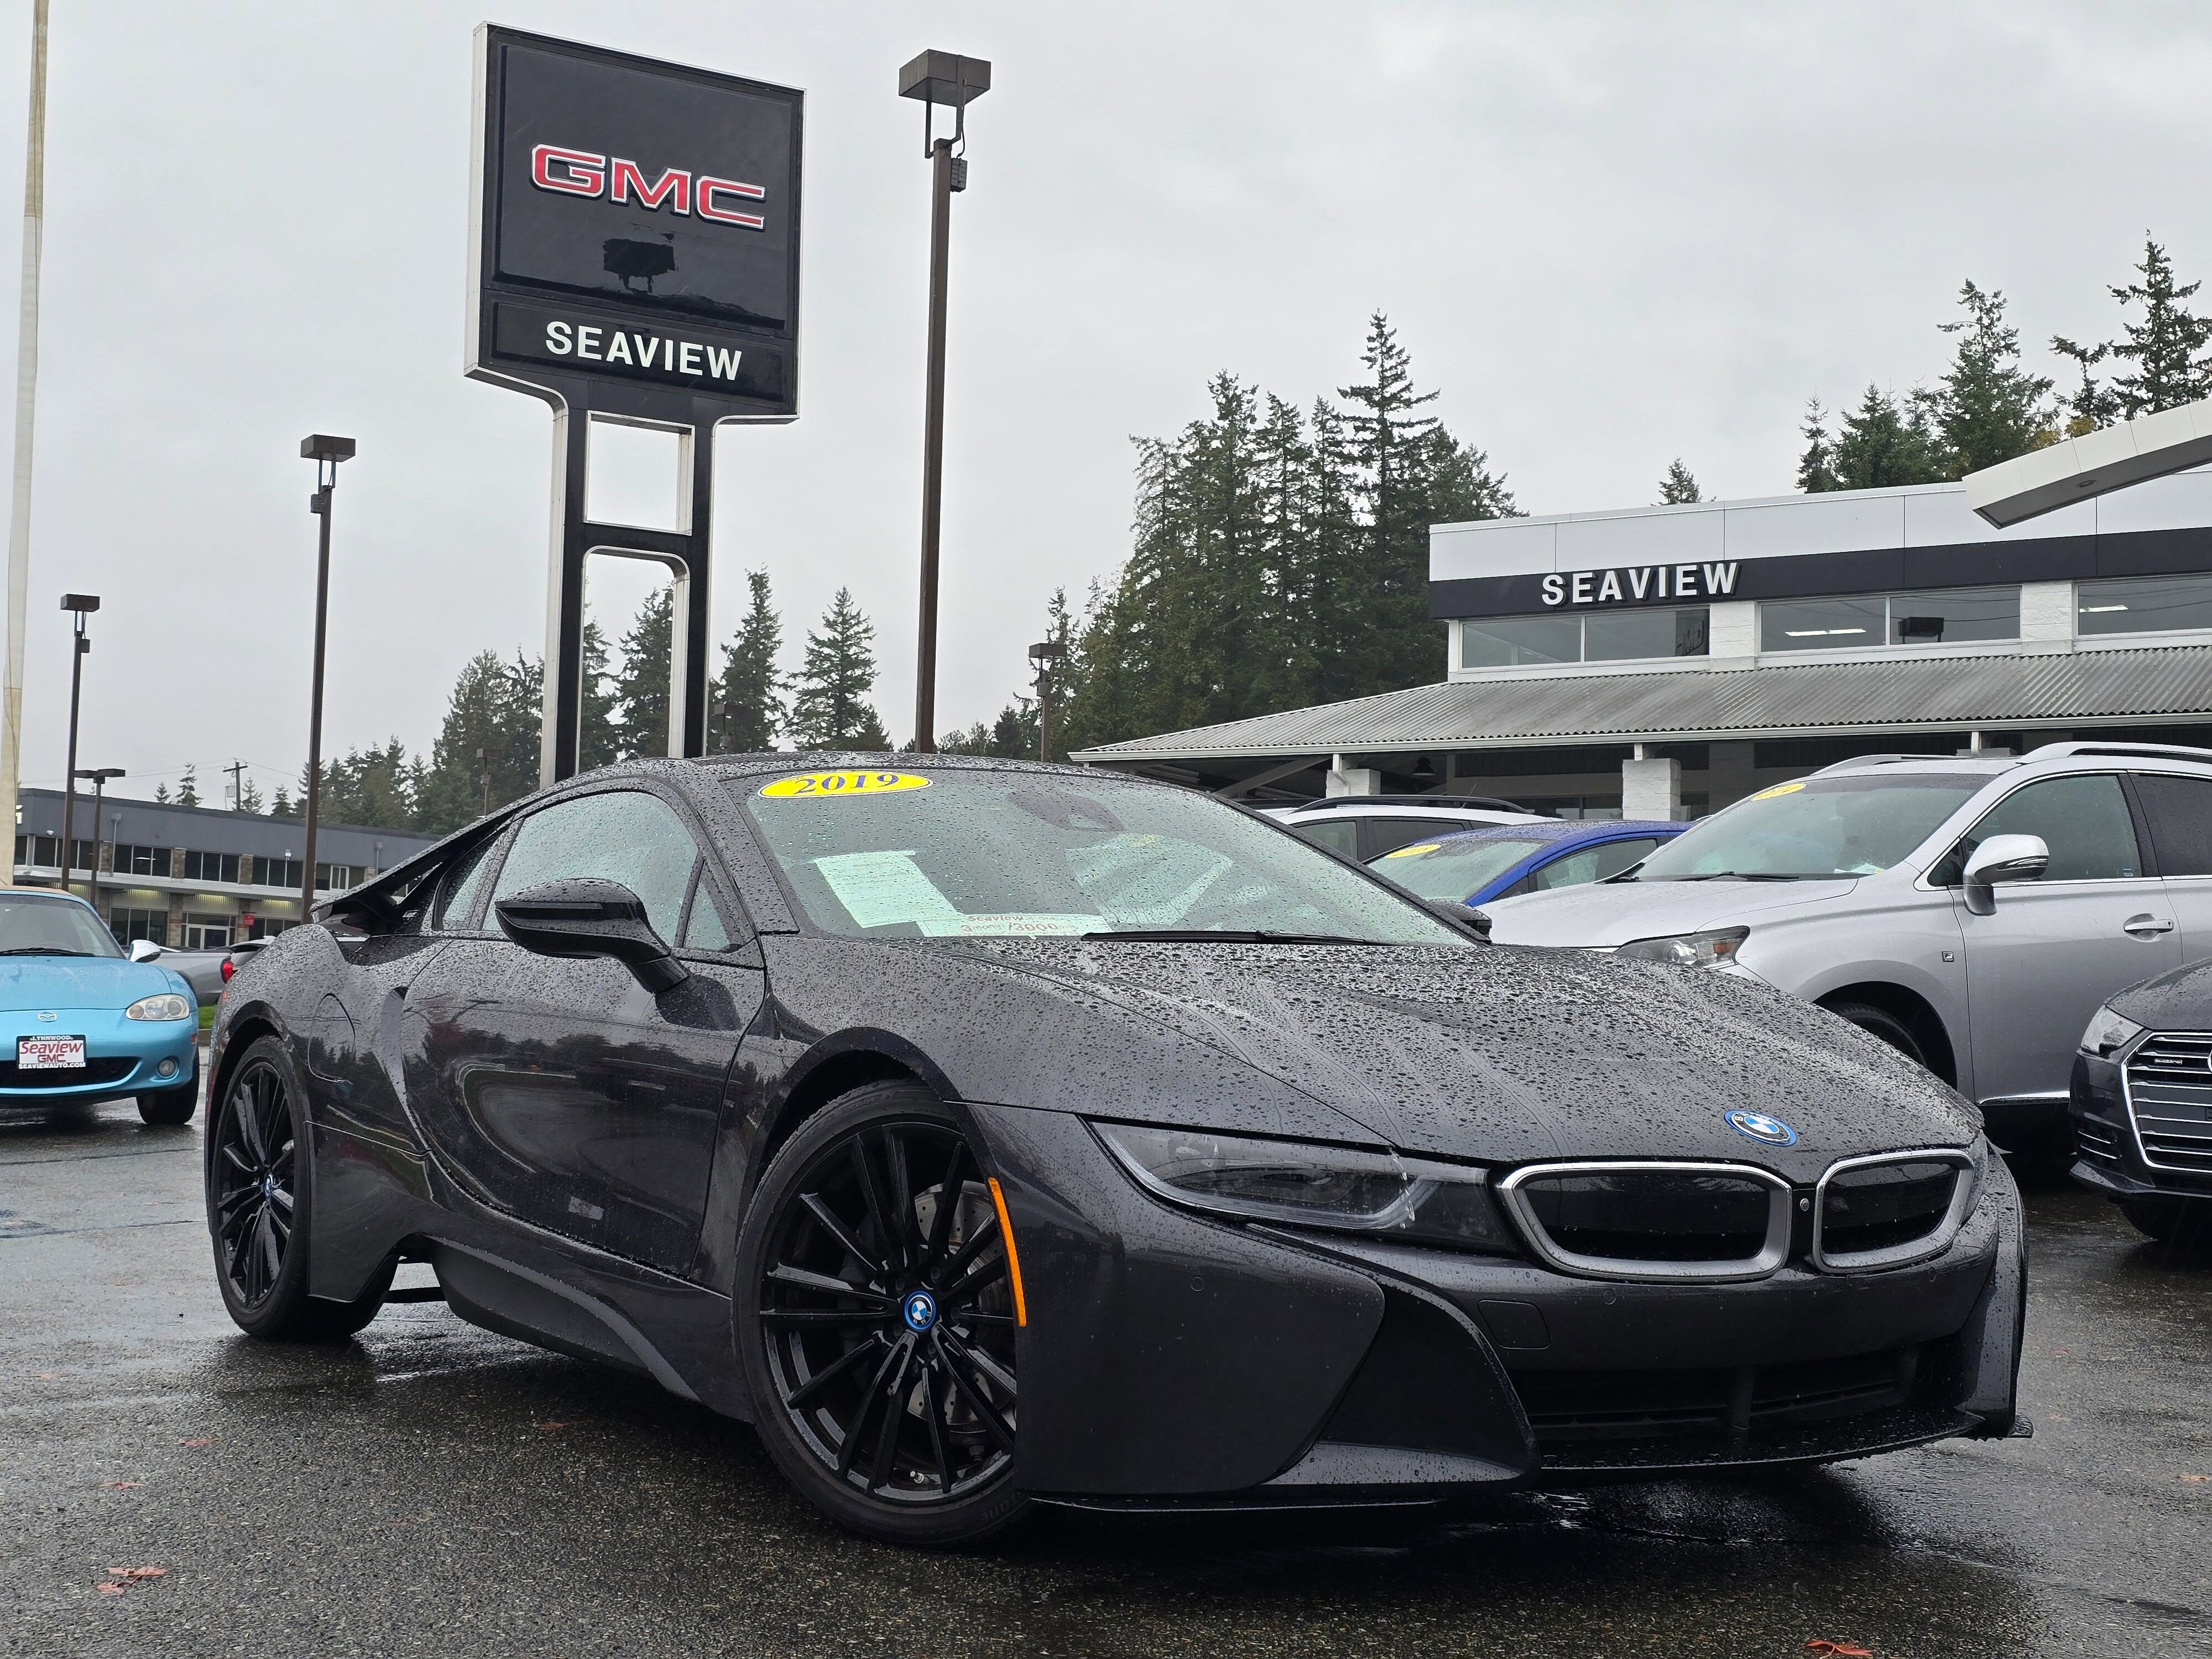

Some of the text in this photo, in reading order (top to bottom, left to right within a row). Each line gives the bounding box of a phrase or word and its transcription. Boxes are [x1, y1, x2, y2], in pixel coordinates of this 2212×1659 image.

[531, 143, 765, 229] GMC
[545, 321, 742, 381] SEAVIEW
[1541, 562, 1740, 606] SEAVIEW
[793, 774, 899, 795] 2019
[20, 1041, 83, 1054] Seaview
[38, 1053, 67, 1063] GMC
